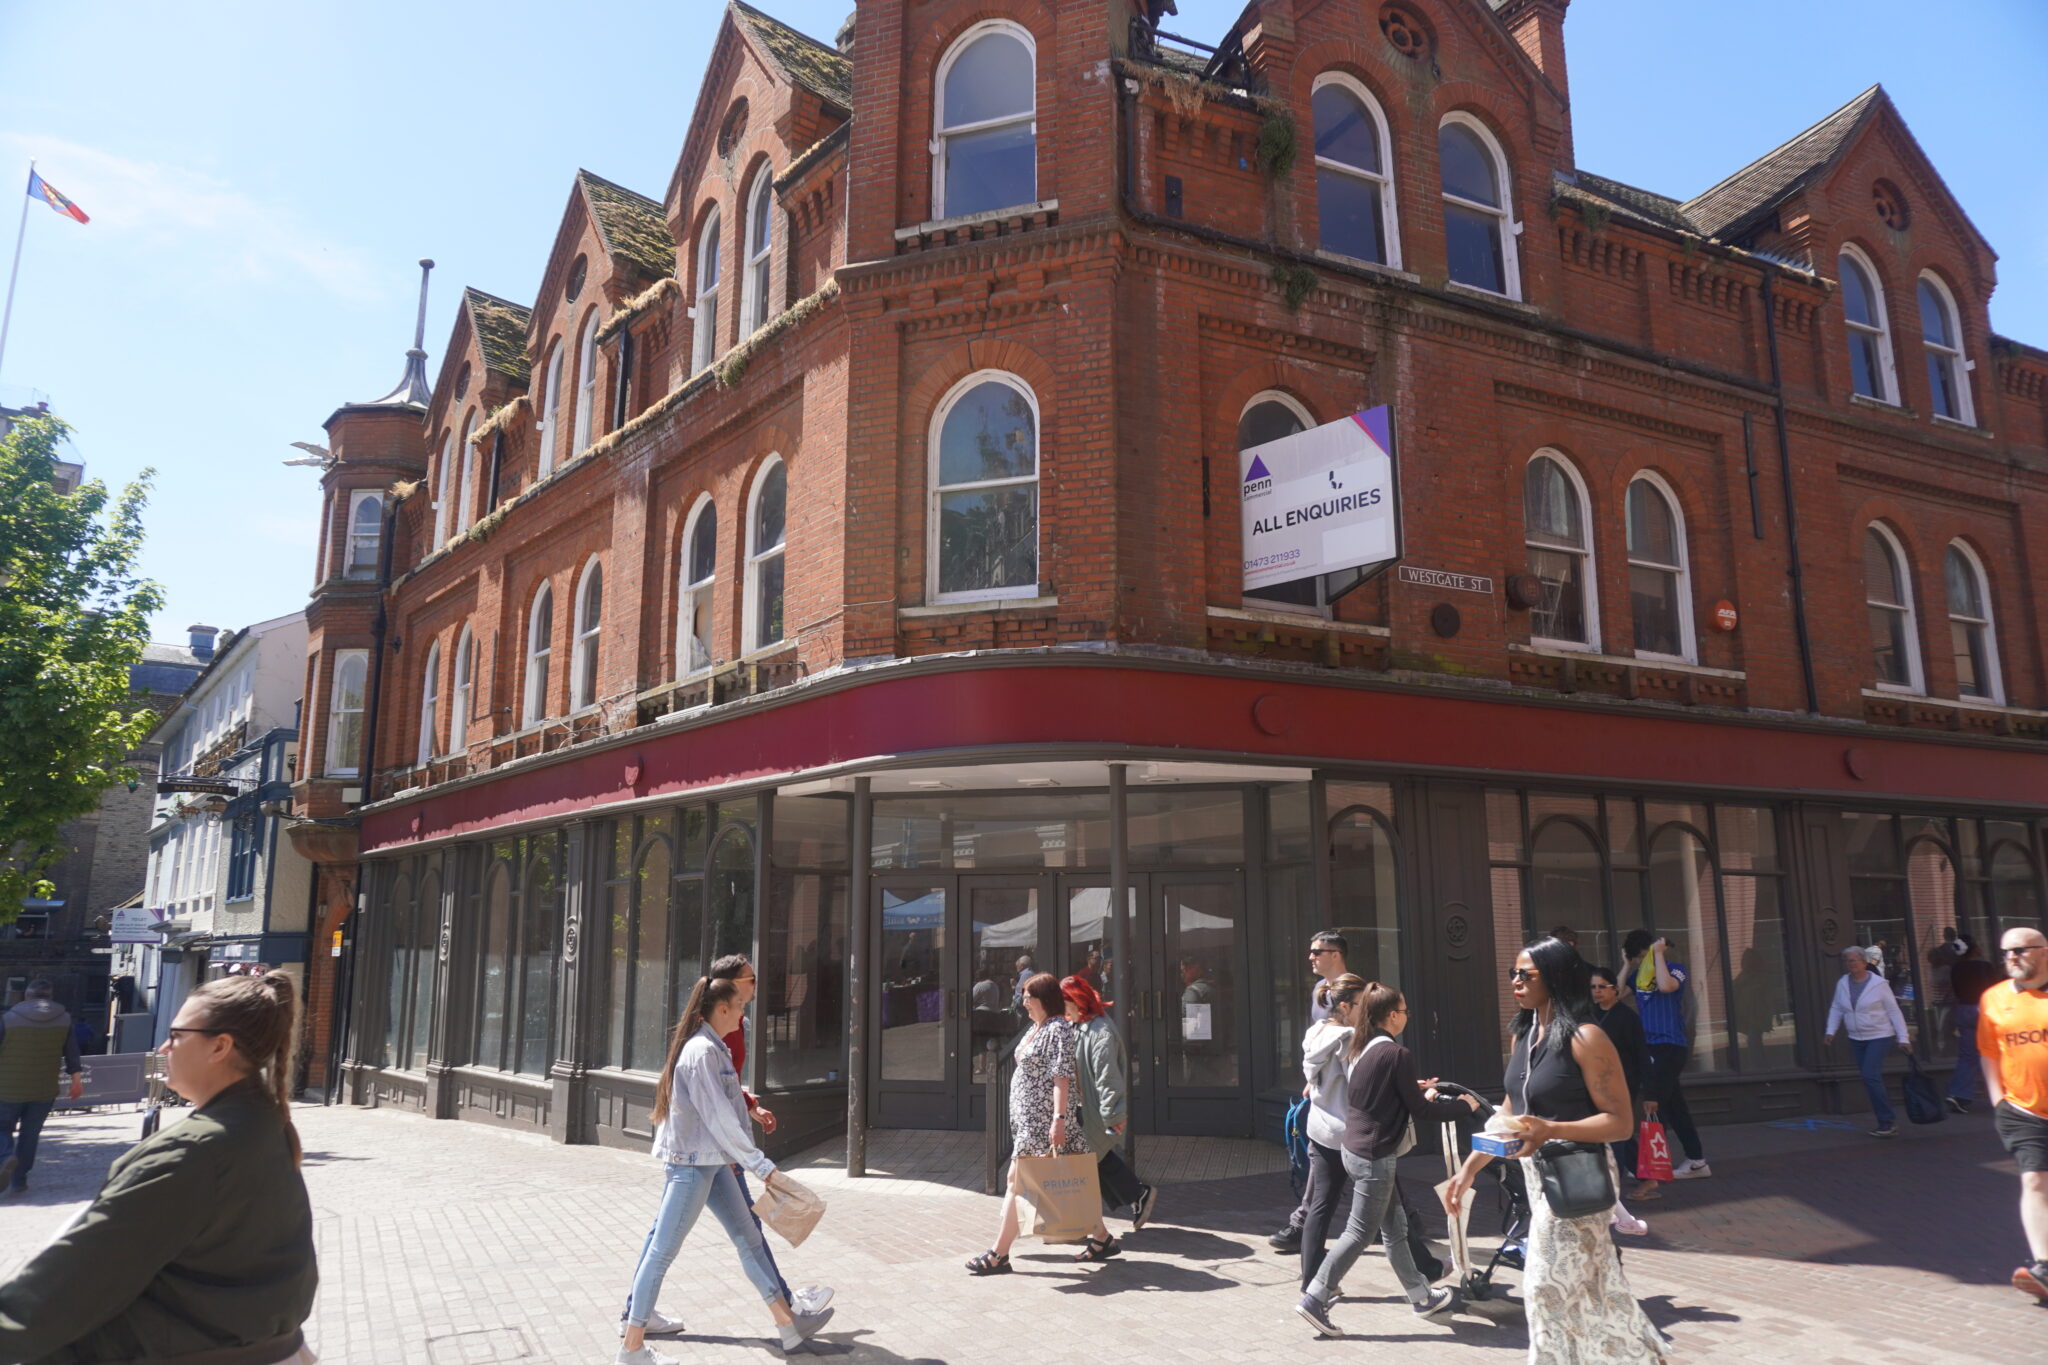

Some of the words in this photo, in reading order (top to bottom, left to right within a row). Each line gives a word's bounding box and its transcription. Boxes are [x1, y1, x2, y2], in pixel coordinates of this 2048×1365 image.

[1243, 479, 1272, 497] penn
[1253, 515, 1283, 536] ALL
[1286, 488, 1381, 527] ENQUIRIES
[1243, 556, 1269, 570] 01473
[1270, 549, 1300, 564] 211933
[1408, 569, 1464, 588] WESTGATE
[1471, 579, 1483, 590] ST
